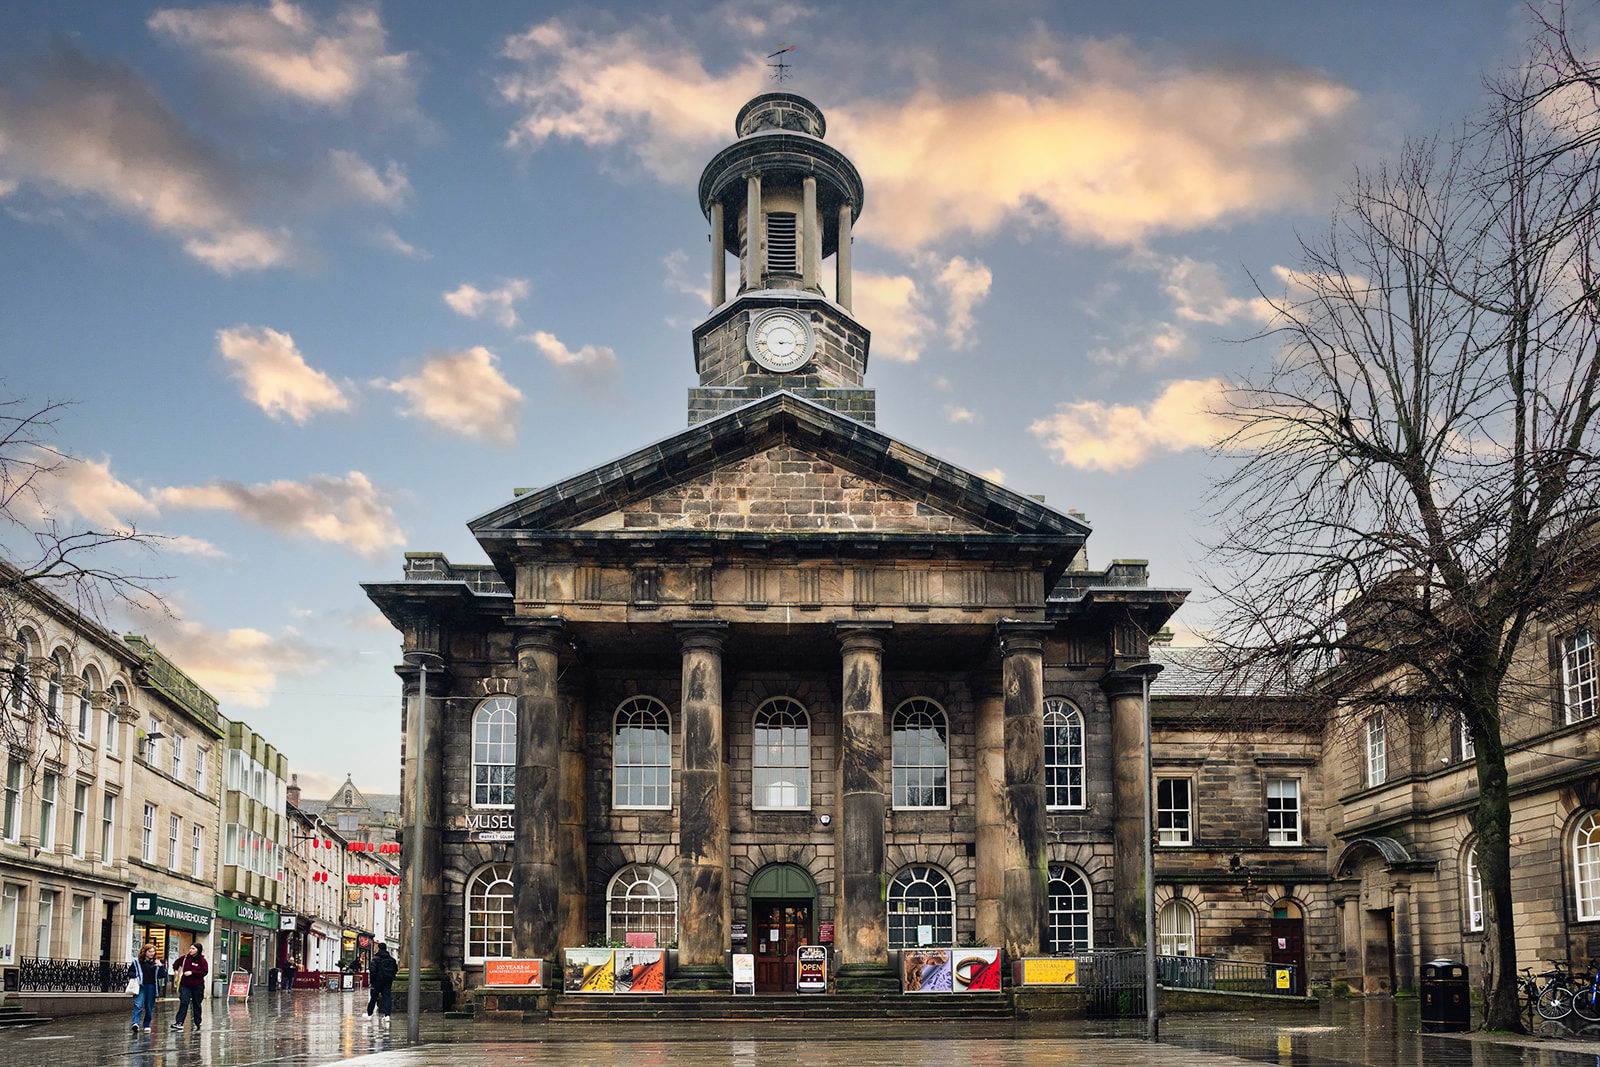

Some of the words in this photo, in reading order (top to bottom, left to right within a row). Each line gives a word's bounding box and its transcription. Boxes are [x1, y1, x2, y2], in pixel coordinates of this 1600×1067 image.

[175, 909, 209, 925] WAREHOUSE
[237, 905, 254, 920] LLOYDS
[253, 909, 265, 923] BANK
[802, 963, 822, 971] OPEN
